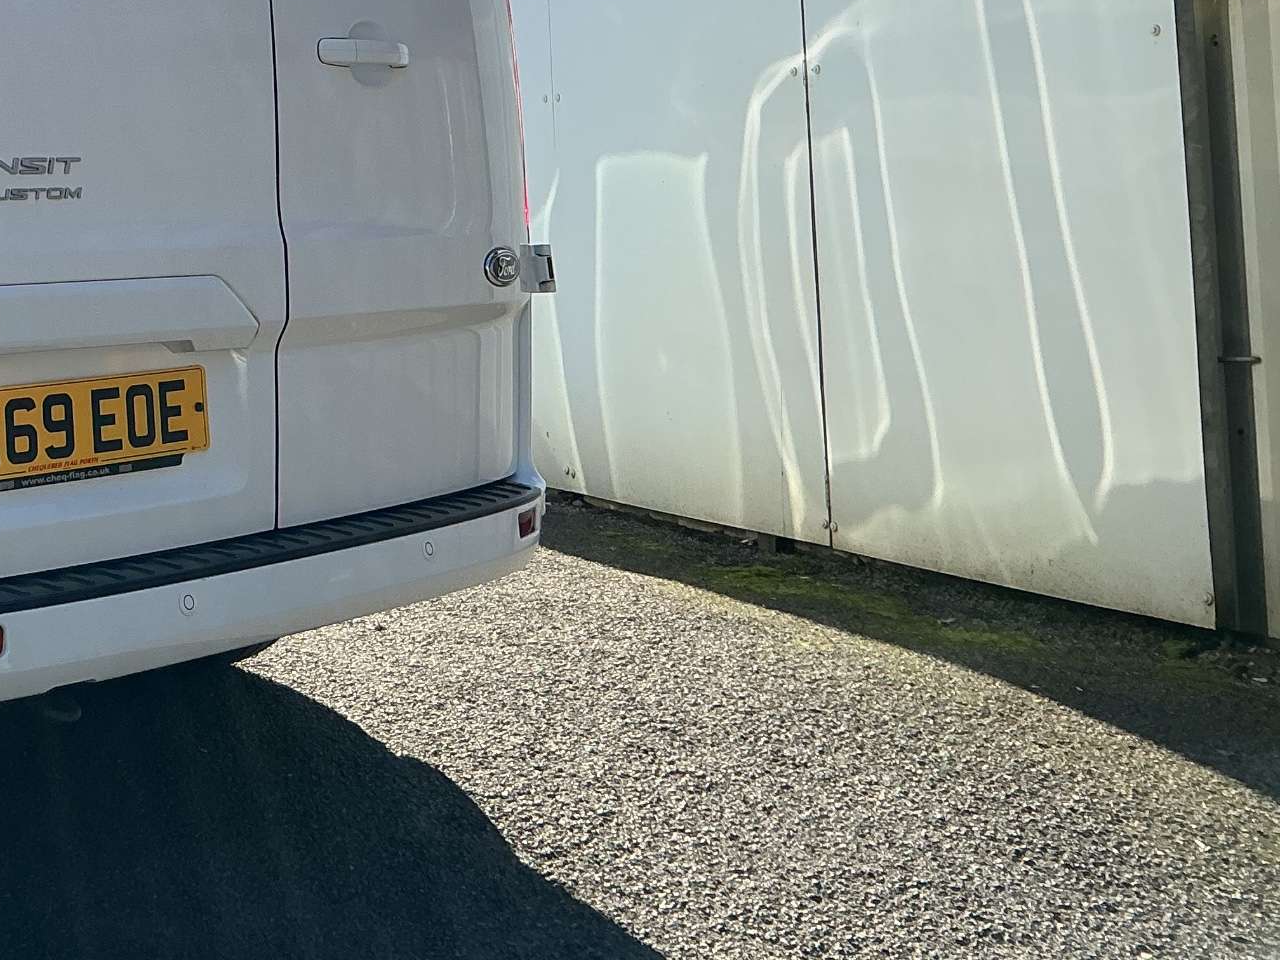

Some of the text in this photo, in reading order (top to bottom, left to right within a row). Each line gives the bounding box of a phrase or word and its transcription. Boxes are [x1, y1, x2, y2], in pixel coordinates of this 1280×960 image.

[497, 256, 516, 277] Ford
[90, 379, 189, 453] EOE
[21, 466, 111, 487] www.cheq-flag.co.uk
